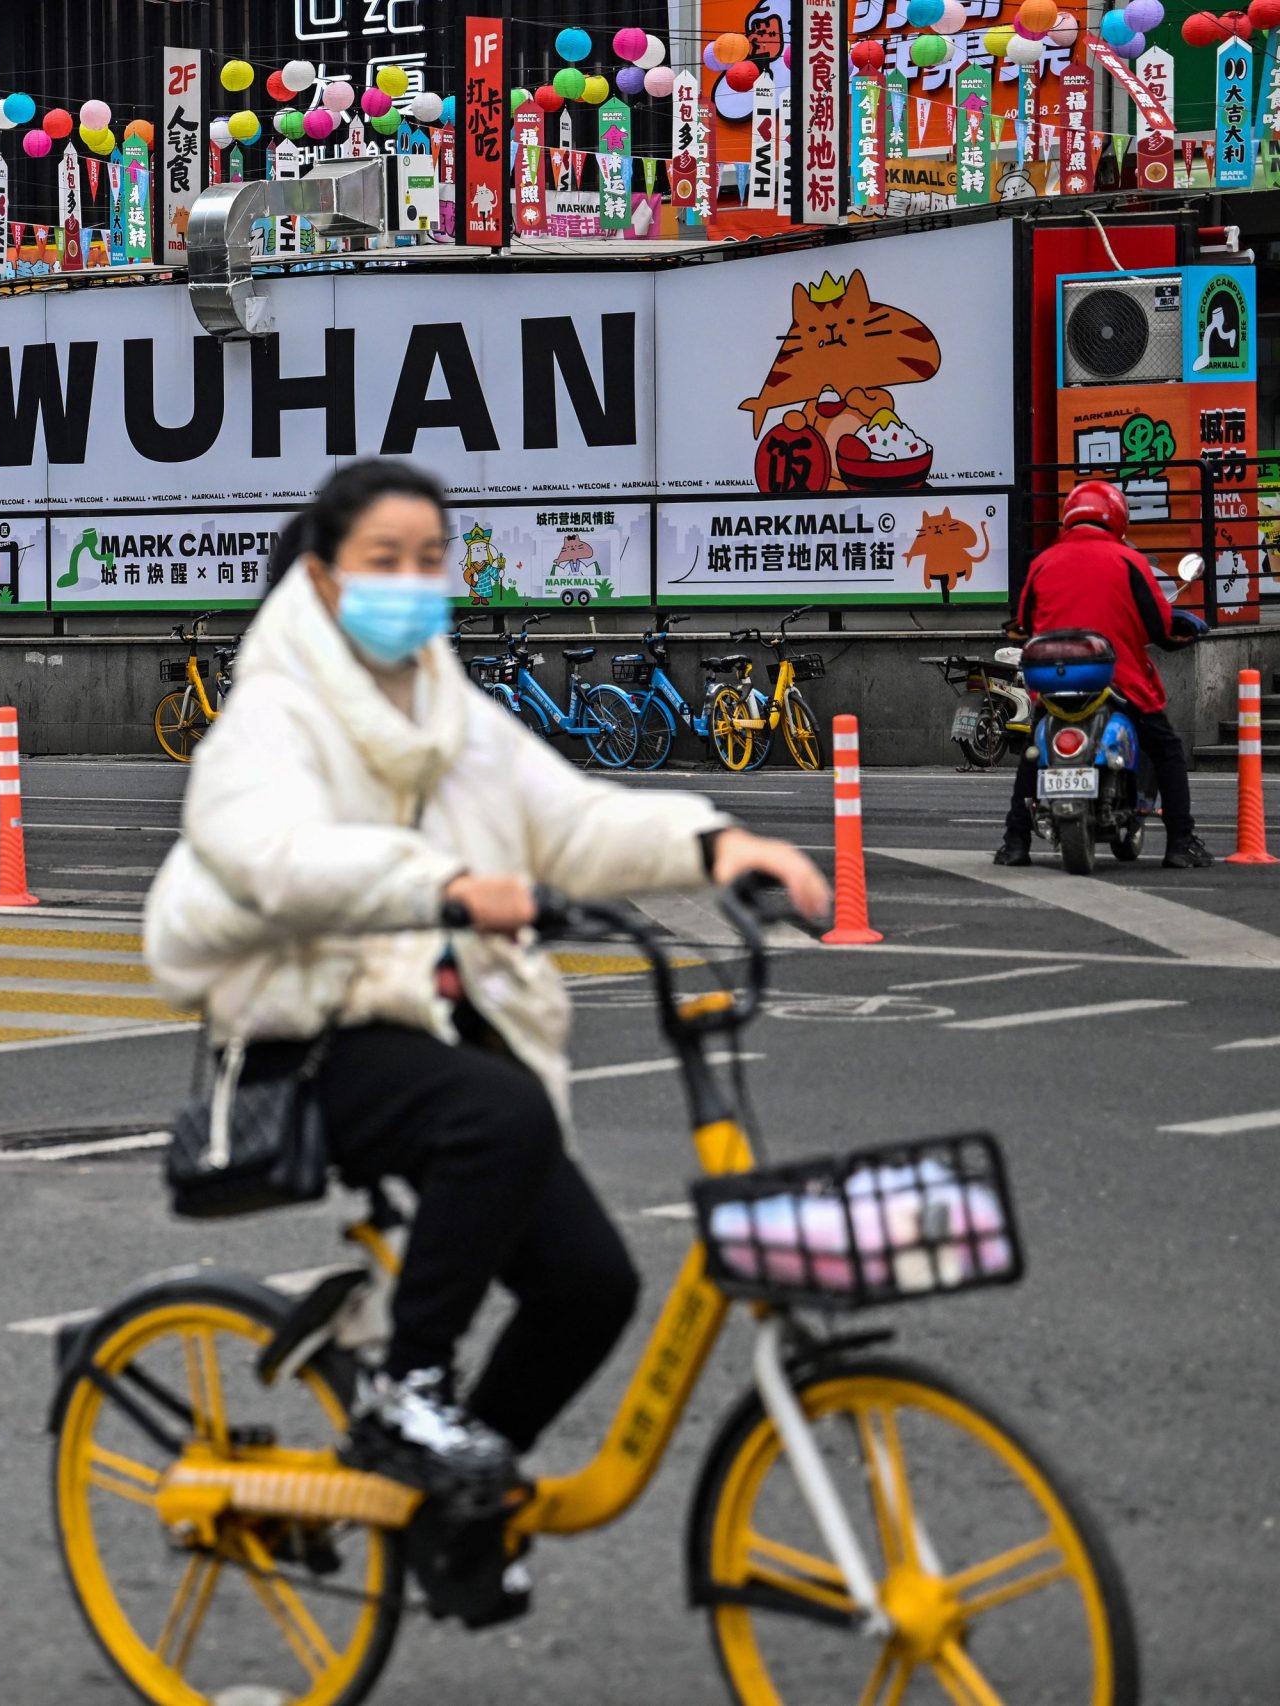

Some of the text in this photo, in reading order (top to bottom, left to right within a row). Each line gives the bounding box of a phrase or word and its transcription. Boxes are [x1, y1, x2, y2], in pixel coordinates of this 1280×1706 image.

[474, 33, 498, 67] 1F
[168, 63, 197, 95] 2F
[467, 78, 502, 162] 打卡小吃
[807, 11, 836, 212] 美食潮地标
[1143, 63, 1167, 151] 红包多
[678, 85, 694, 168] 红包多多
[1223, 84, 1246, 163] 大吉大利
[167, 105, 199, 193] 人气美食
[857, 95, 880, 197] 今日宜食味
[66, 156, 77, 230] 红包多多
[470, 218, 497, 231] mark
[168, 240, 188, 250] mar
[1201, 278, 1246, 314] COME CAMPING
[1204, 361, 1240, 369] ARKMALL
[1074, 408, 1132, 423] MARKMALL
[34, 497, 68, 505] MARKMALL
[191, 493, 225, 501] MARKMALL
[272, 490, 307, 498] MARKMALL
[668, 480, 703, 488] WELCOME
[715, 478, 754, 487] MARKMALL
[924, 472, 949, 481] MALL
[957, 470, 995, 479] WELCOME
[1203, 492, 1242, 503] ARK
[536, 511, 615, 526] 城市营地风情街
[710, 513, 874, 537] MARKMALL
[1203, 505, 1240, 518] ALL
[101, 534, 173, 558] MARK
[708, 541, 895, 572] 城市营地风情街
[544, 578, 599, 586] MARKMALL
